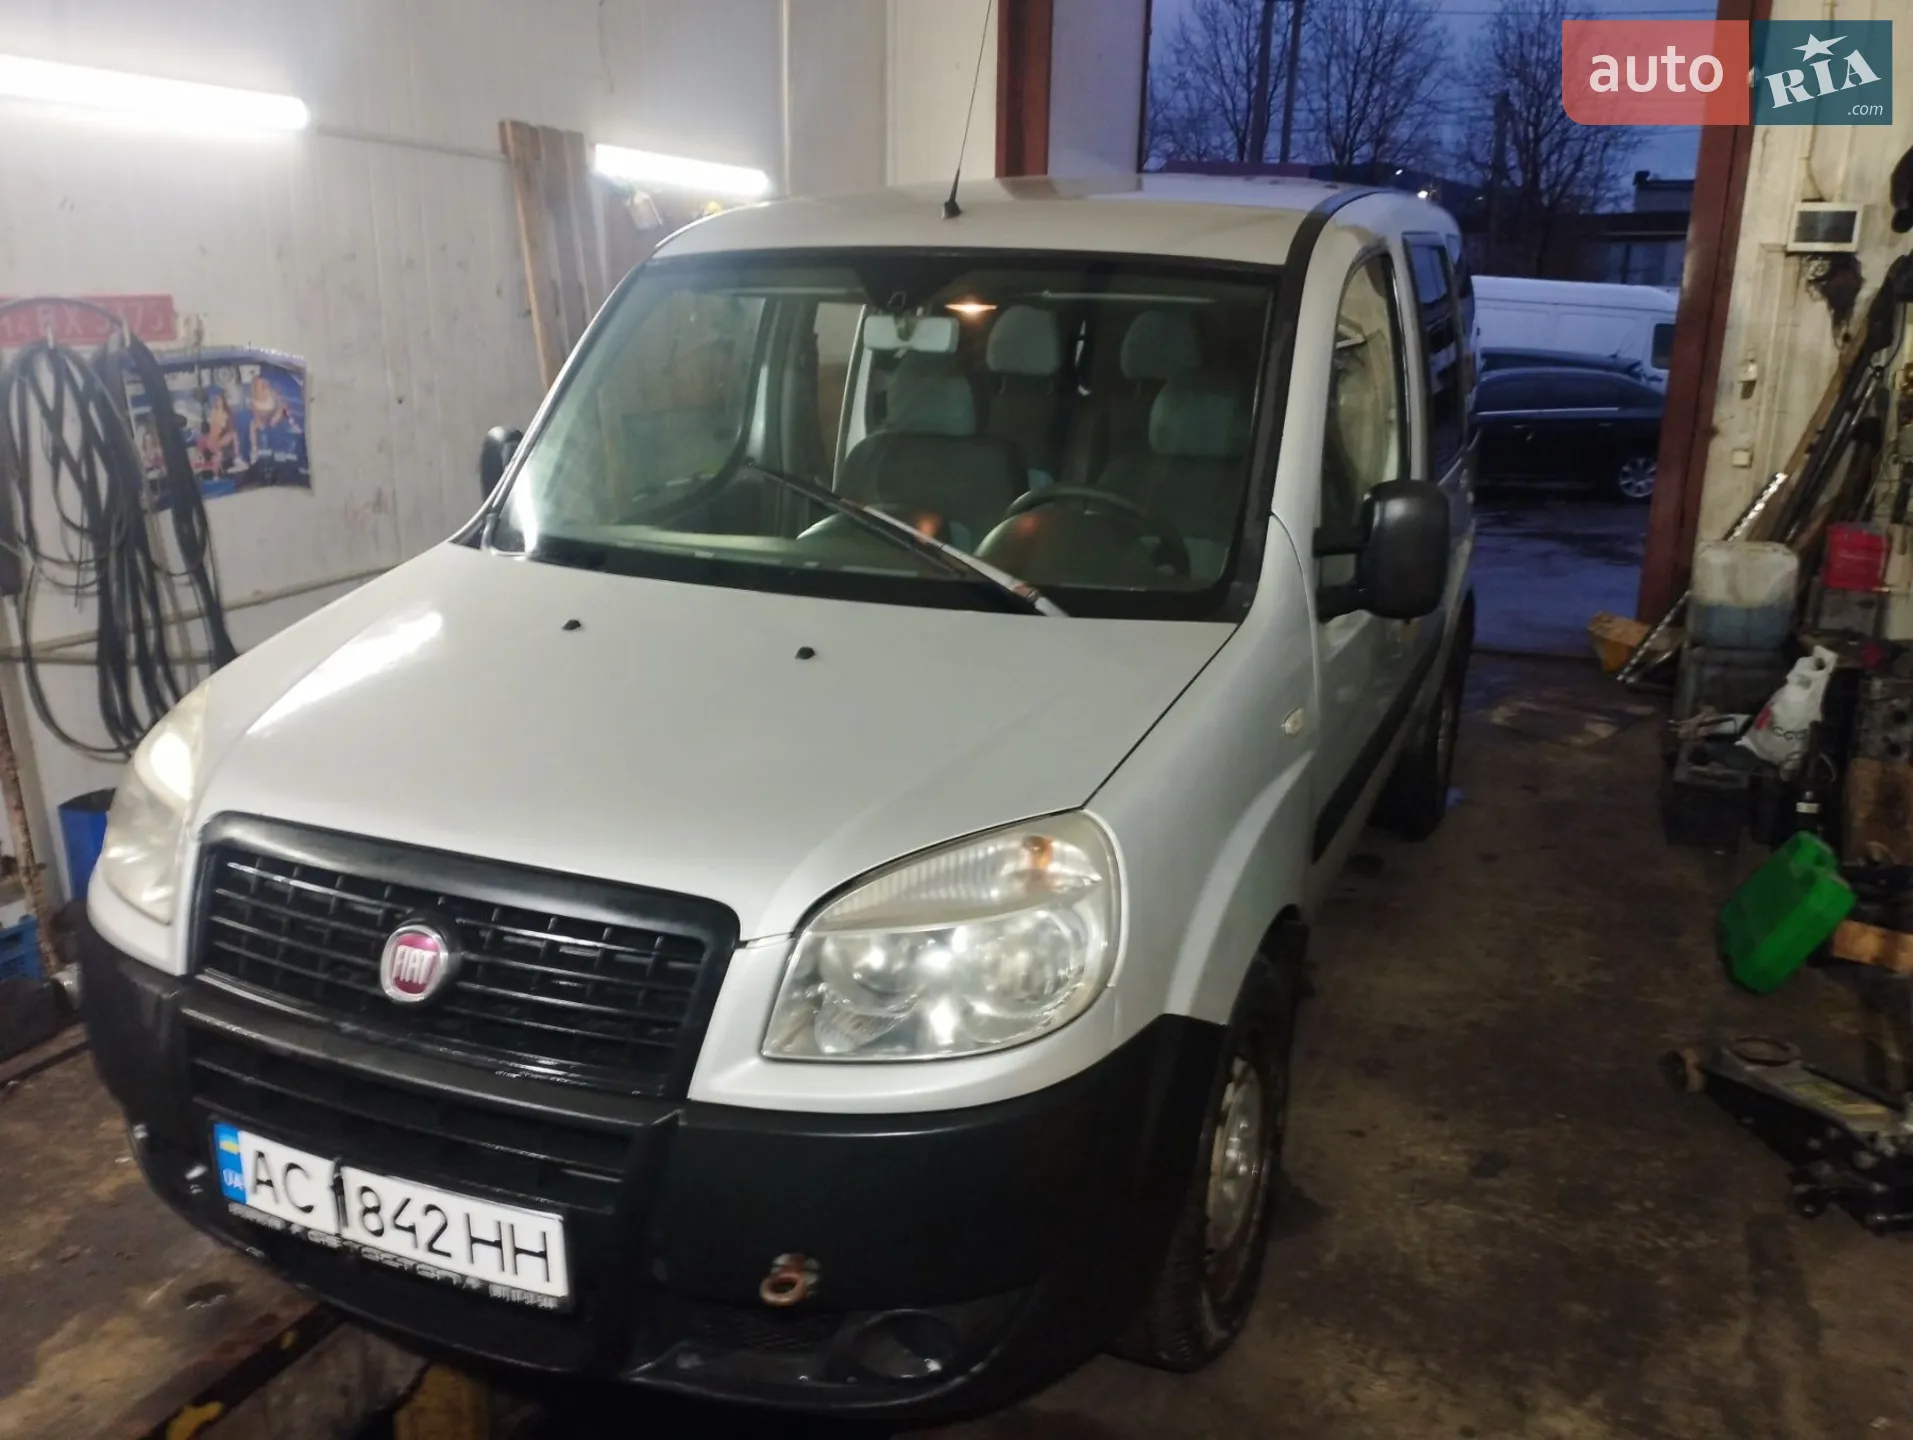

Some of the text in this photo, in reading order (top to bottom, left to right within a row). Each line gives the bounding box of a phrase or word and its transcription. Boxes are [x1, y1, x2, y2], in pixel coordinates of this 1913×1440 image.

[391, 944, 438, 985] FIAT
[222, 1167, 245, 1191] UA
[251, 1150, 314, 1214] AC
[463, 1211, 551, 1283] HH
